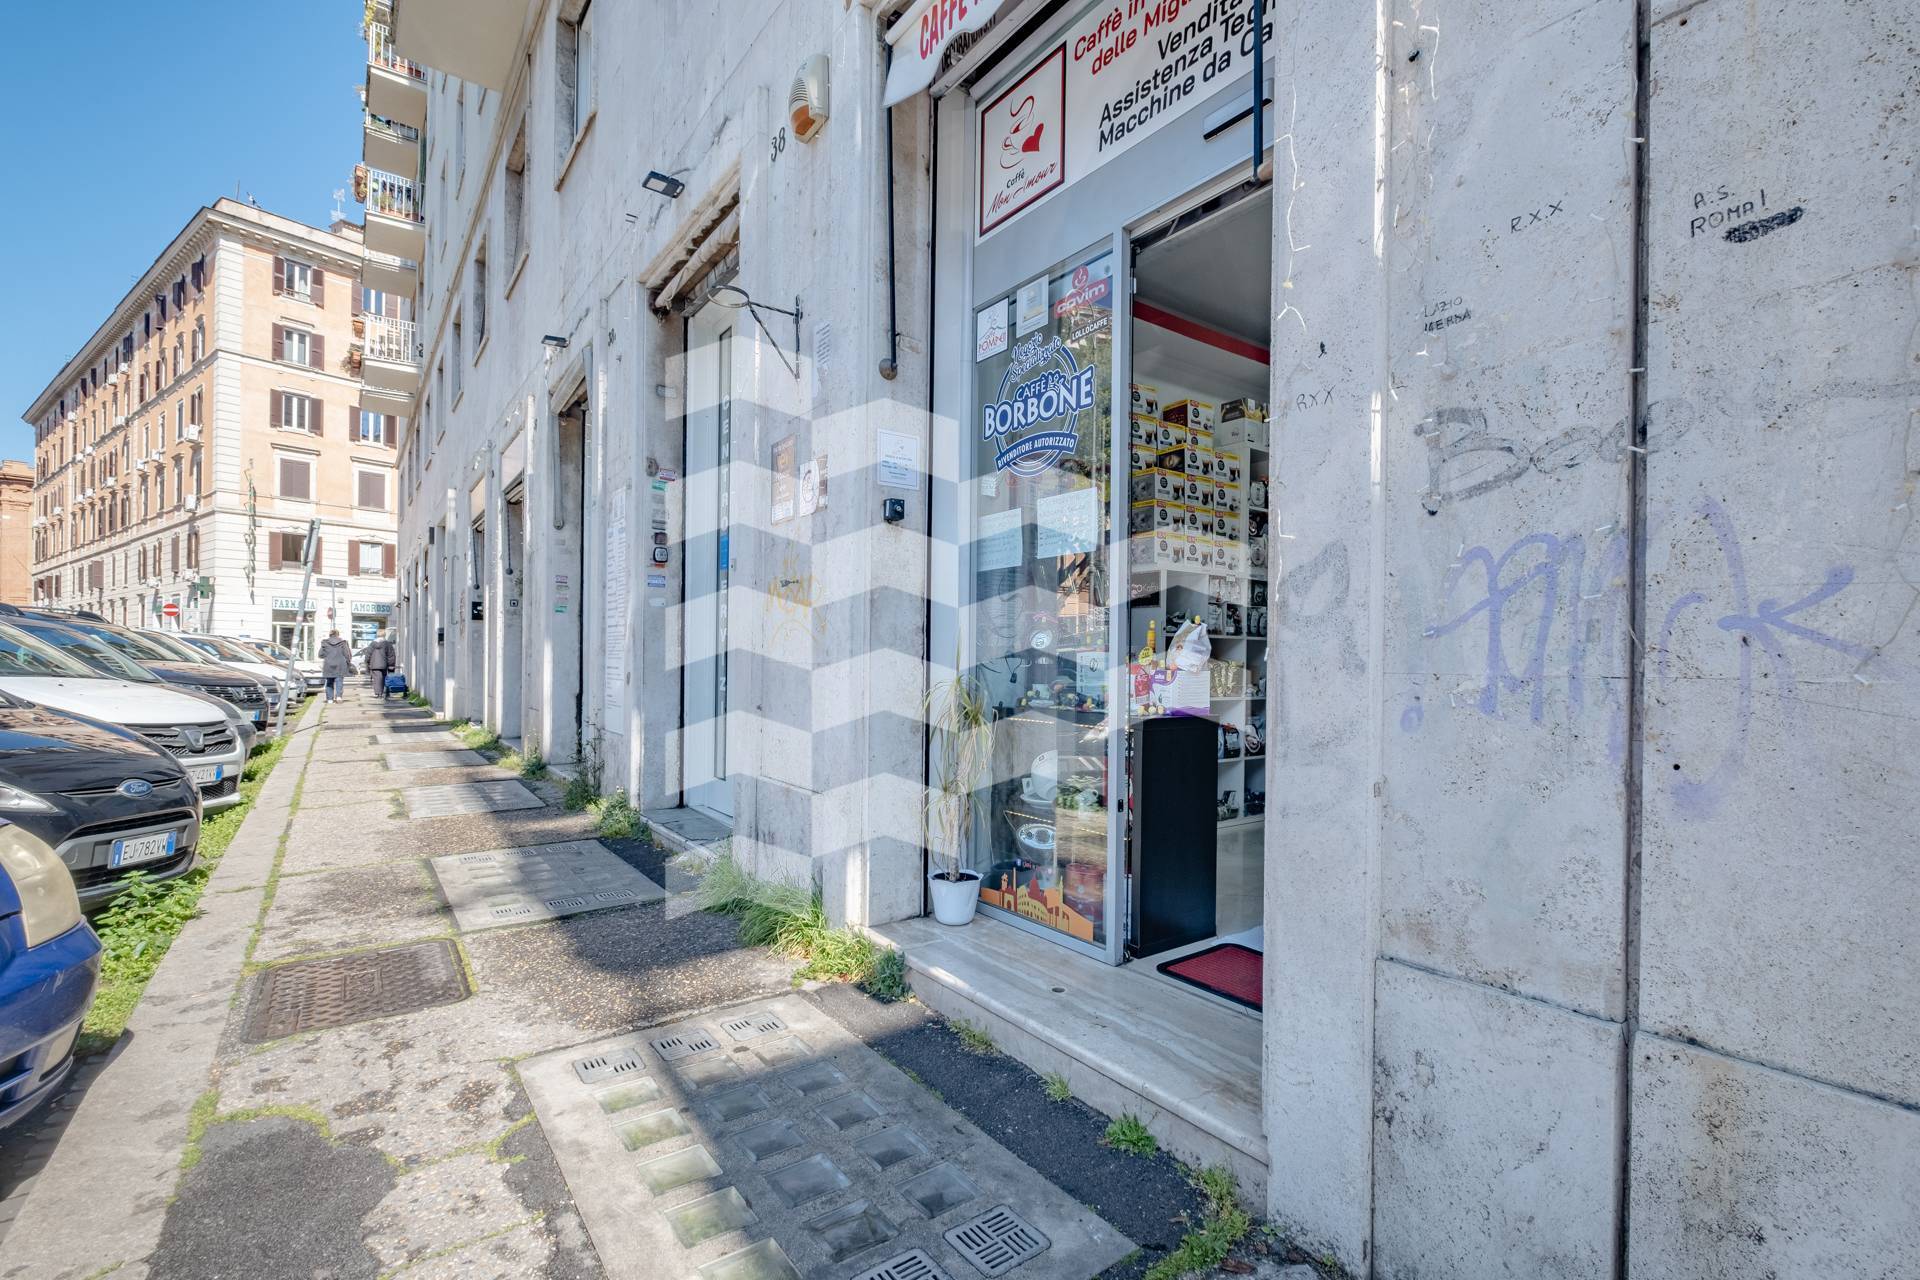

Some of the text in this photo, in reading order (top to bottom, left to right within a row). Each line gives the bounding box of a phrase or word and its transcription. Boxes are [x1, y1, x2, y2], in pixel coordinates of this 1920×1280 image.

[1074, 7, 1123, 61] Caffè
[1091, 28, 1138, 76] delle
[1157, 0, 1244, 60] Vendita
[1098, 74, 1196, 153] Macchine
[1203, 50, 1232, 83] da
[1099, 36, 1214, 129] Assistenza
[770, 127, 786, 162] 38
[984, 369, 1094, 439] BORBONE
[997, 437, 1076, 468] RIVENDITORE AUTORIZZATO
[353, 601, 391, 613] AMOROSO
[130, 782, 147, 793] Ford
